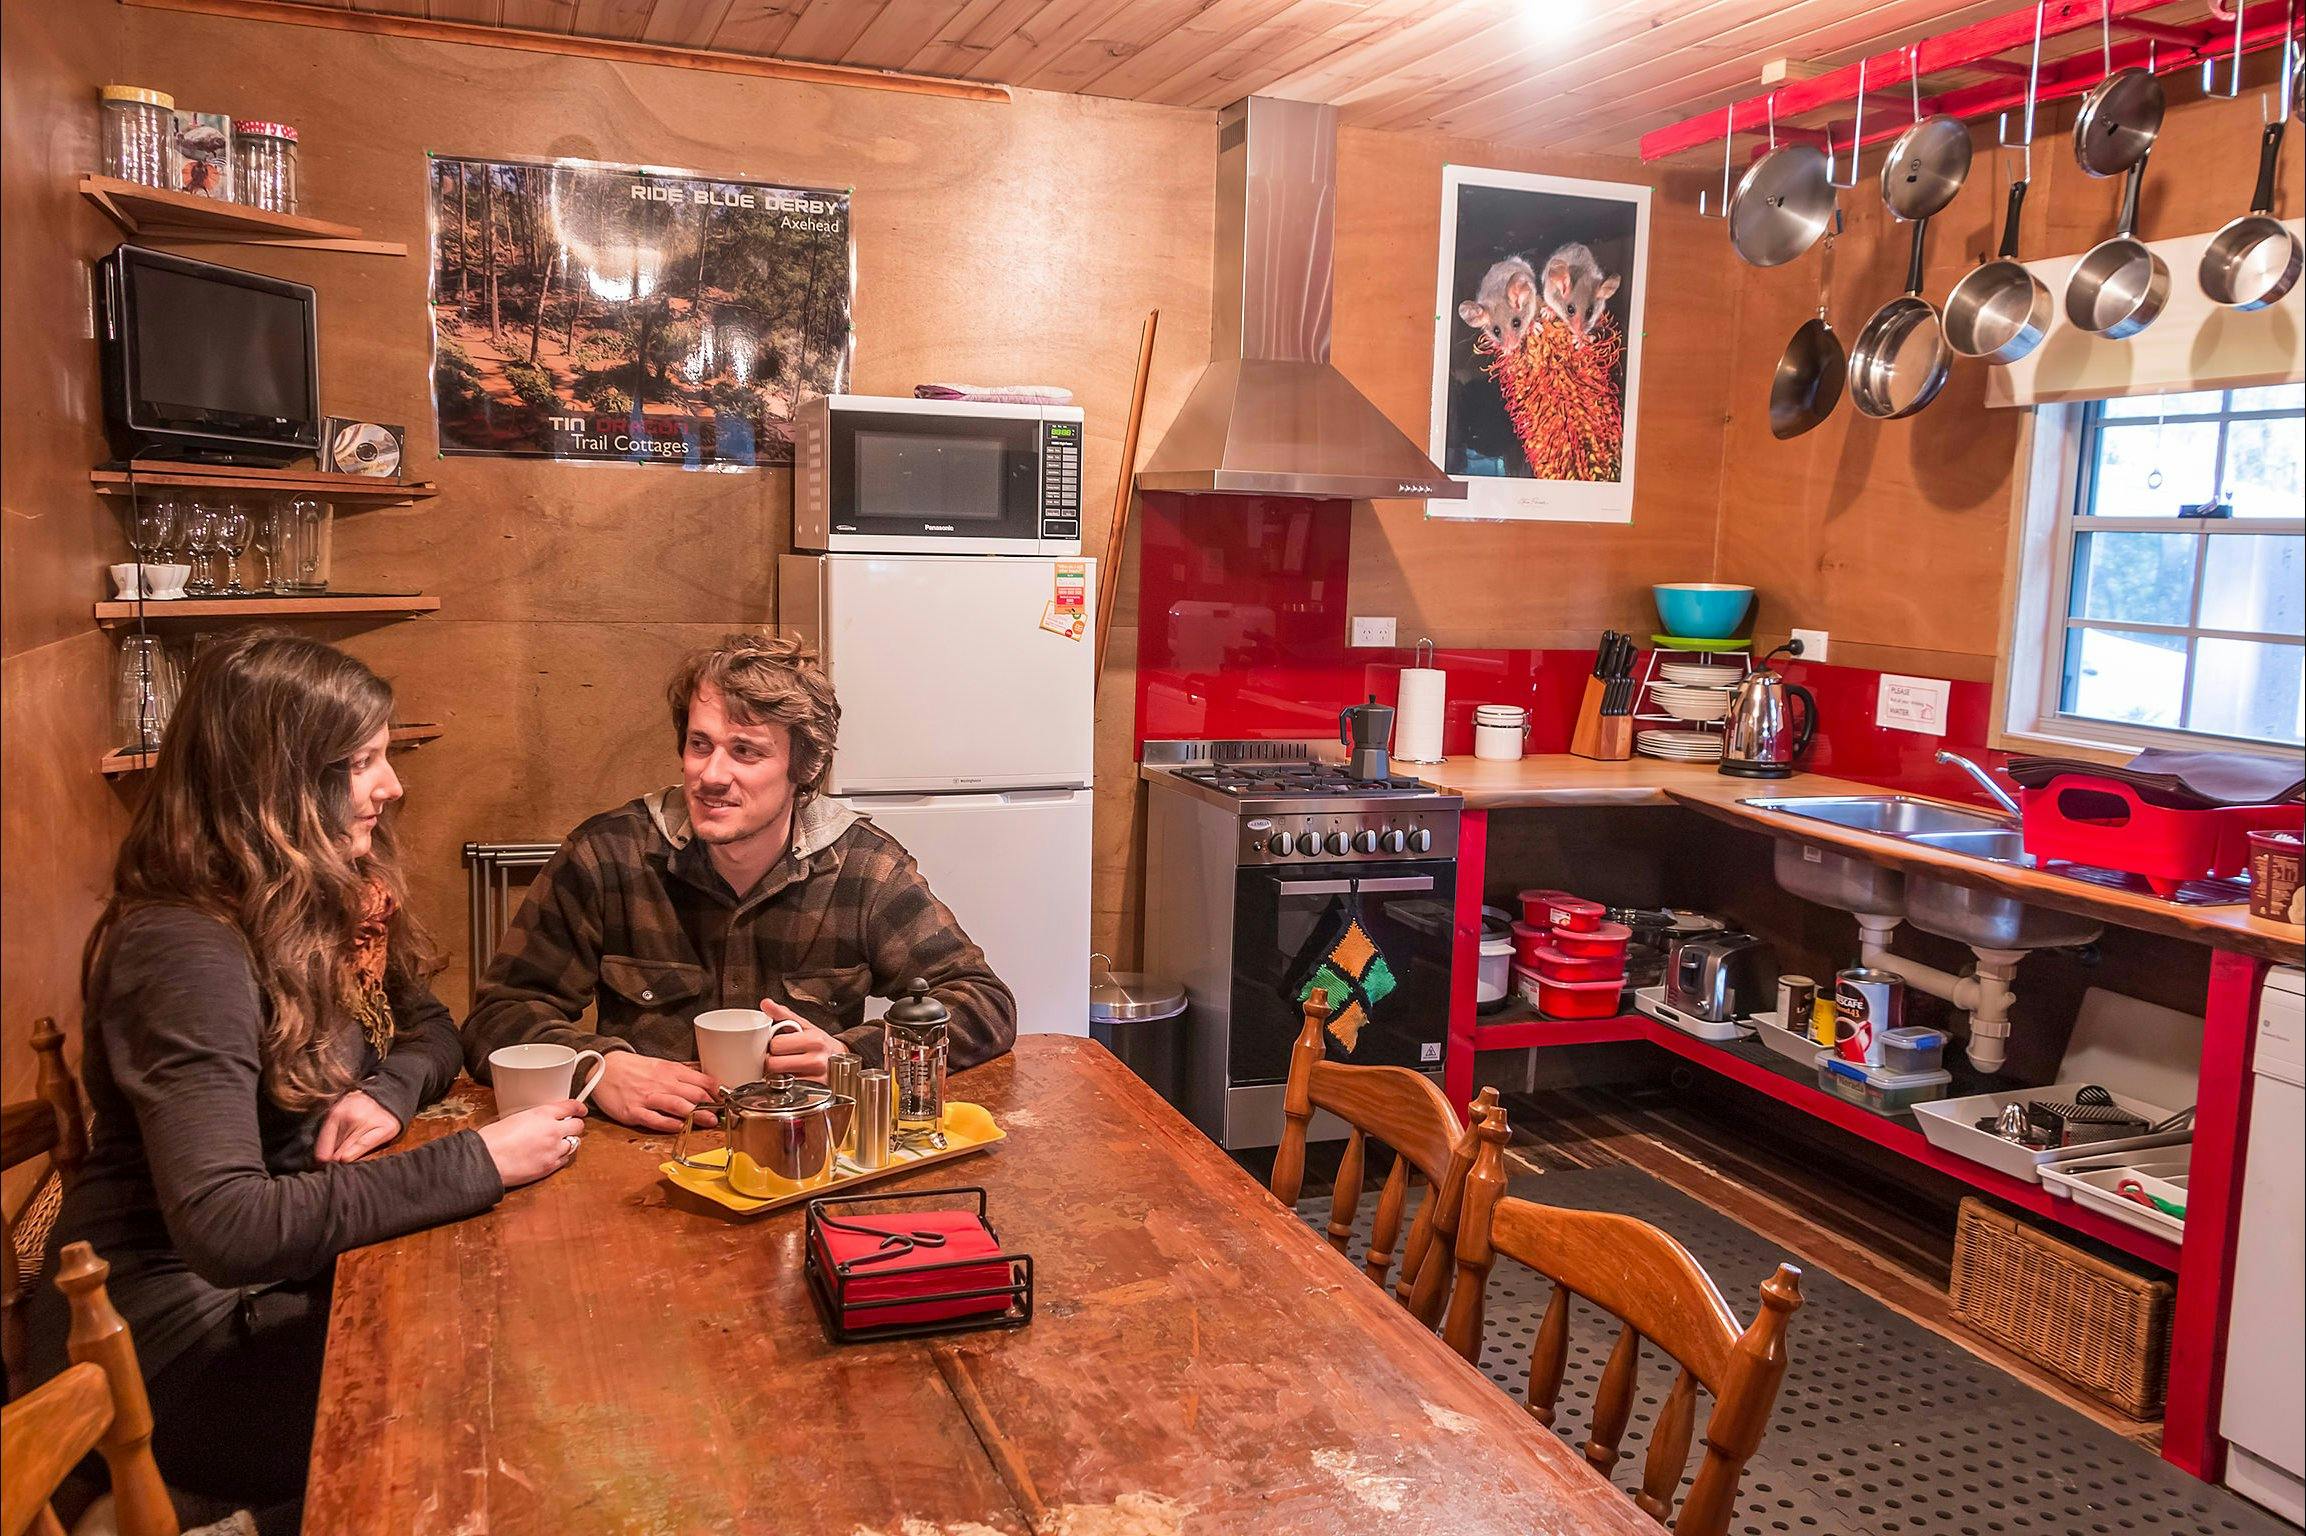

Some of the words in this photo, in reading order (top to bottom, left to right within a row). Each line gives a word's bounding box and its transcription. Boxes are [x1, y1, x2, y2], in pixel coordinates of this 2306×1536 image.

[631, 185, 683, 203] RIDE
[693, 190, 755, 209] BLUE
[765, 197, 838, 216] DERBY
[780, 216, 839, 233] Axehead
[548, 417, 586, 432] TIN
[596, 419, 689, 435] DRAGON
[571, 433, 608, 450] Trail
[614, 435, 689, 457] Cottages
[924, 524, 955, 532] Panasonic
[1890, 687, 1910, 696] PLEASE
[1889, 707, 1909, 716] WATER
